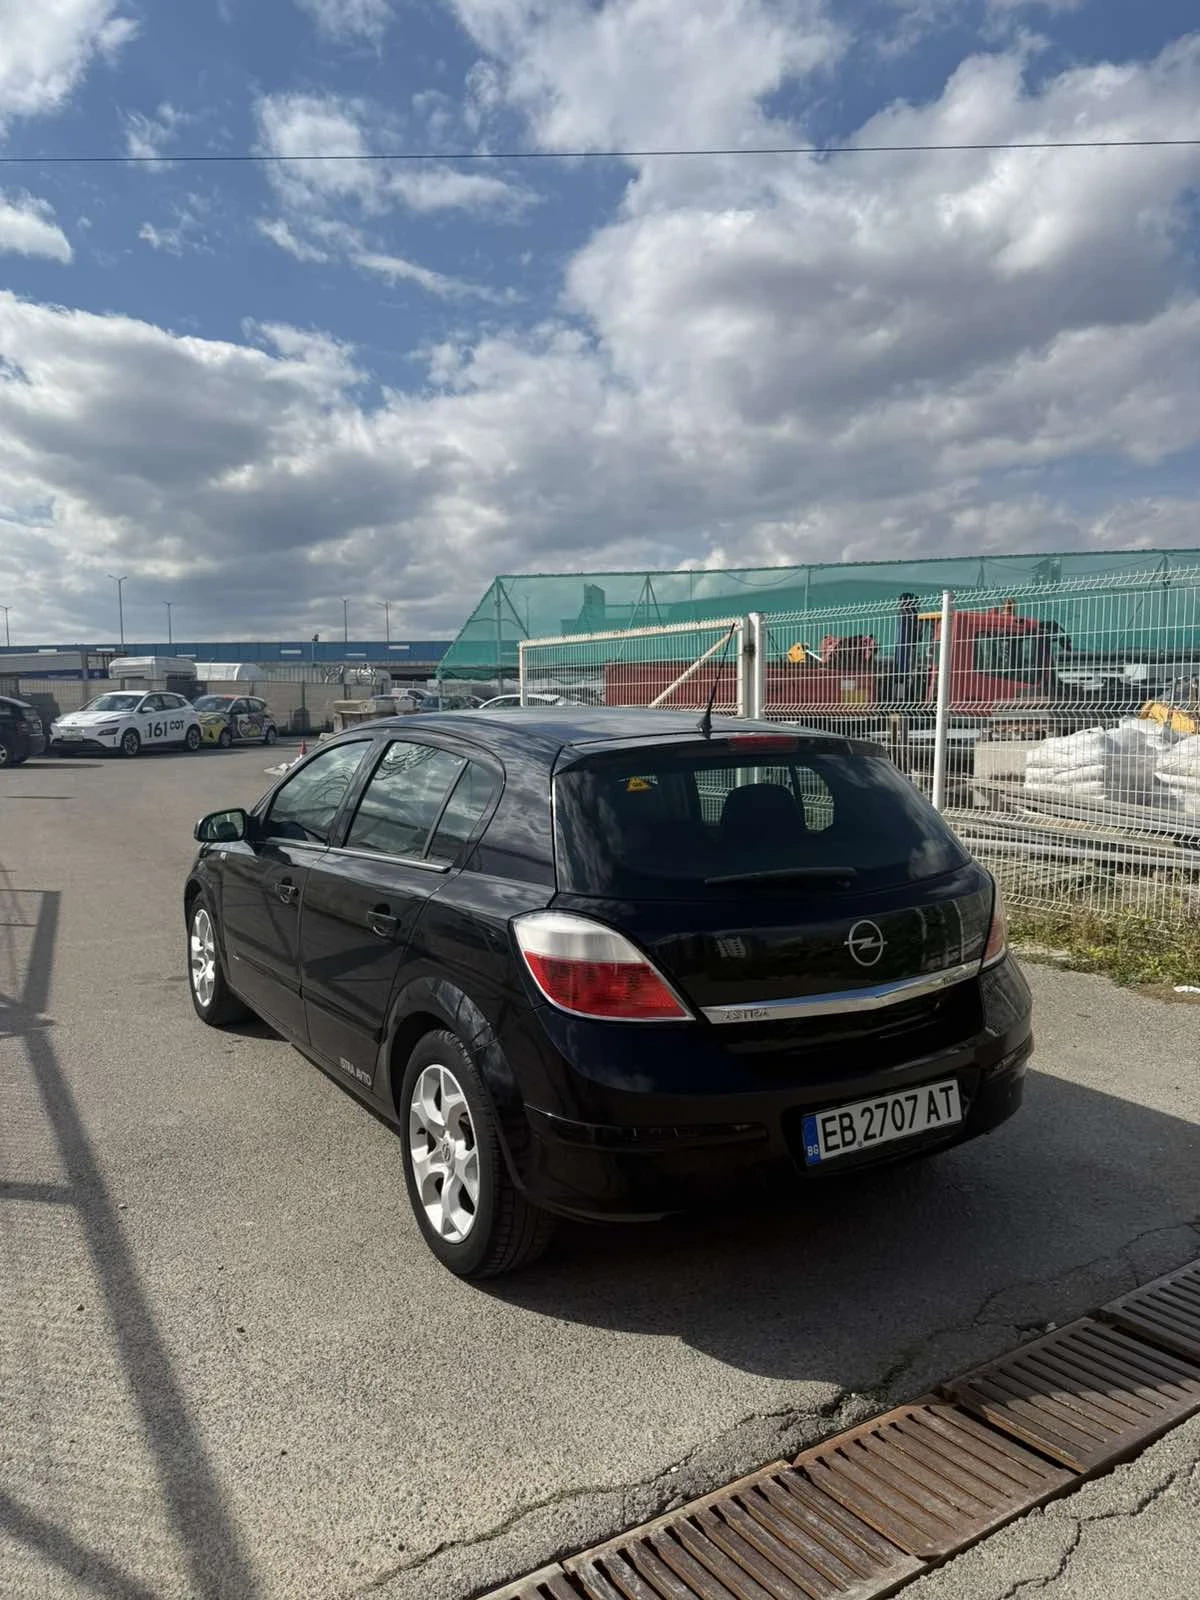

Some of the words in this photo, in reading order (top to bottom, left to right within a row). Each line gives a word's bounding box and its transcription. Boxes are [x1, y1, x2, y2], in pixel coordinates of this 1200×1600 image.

[147, 721, 167, 738] 161
[721, 1007, 769, 1020] ASTRA
[821, 1112, 856, 1153] EB
[860, 1094, 919, 1142] 2707
[927, 1086, 953, 1124] AT
[806, 1144, 819, 1157] BG
